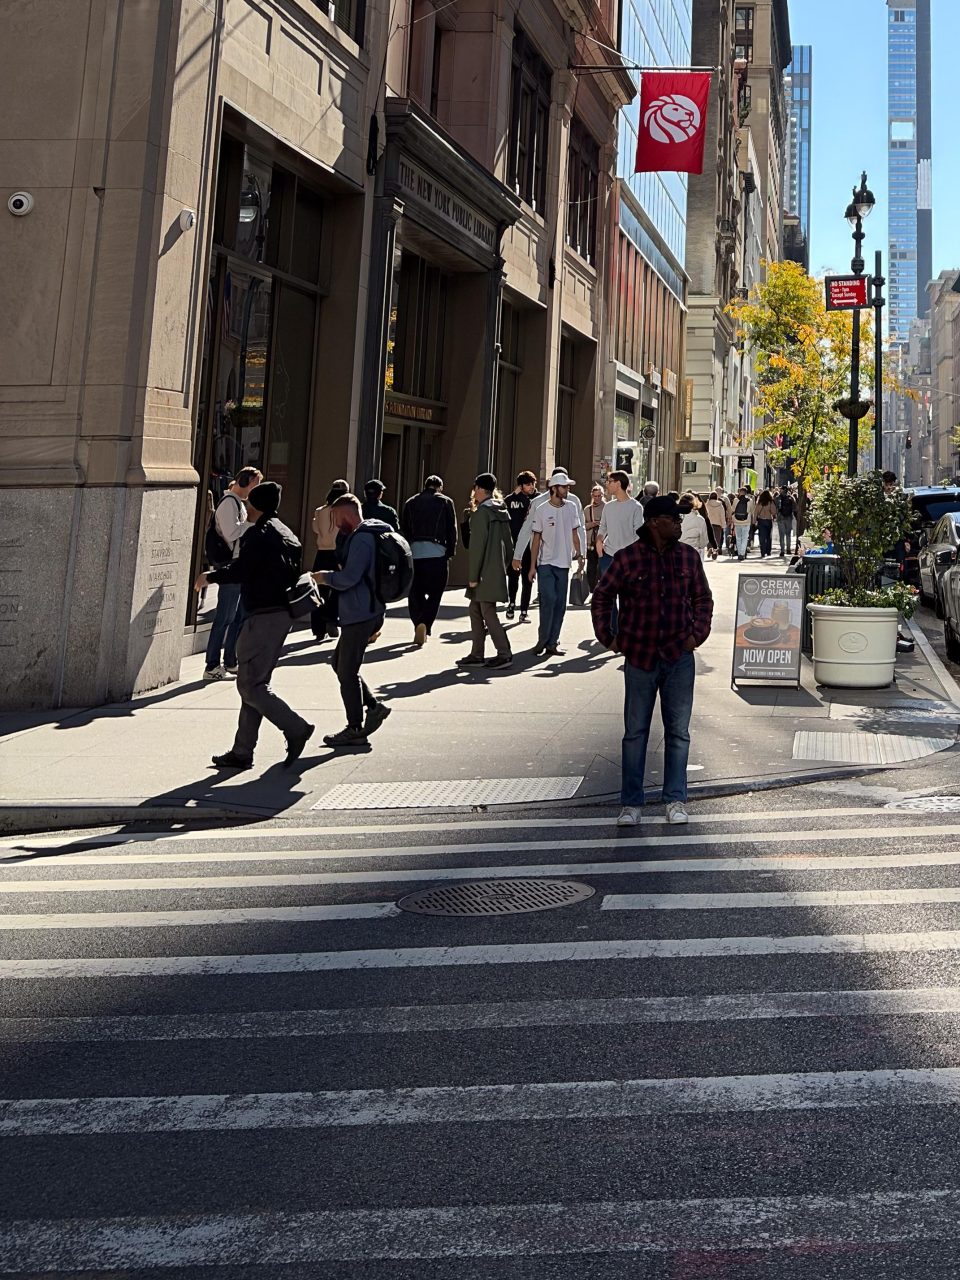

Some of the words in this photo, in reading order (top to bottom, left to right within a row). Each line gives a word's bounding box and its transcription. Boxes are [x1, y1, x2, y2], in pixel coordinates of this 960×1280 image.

[400, 161, 415, 192] THE
[417, 176, 432, 204] NEW
[434, 187, 451, 217] YORK
[451, 200, 472, 232] PUBLIC
[473, 220, 495, 248] LIBRARY
[760, 579, 800, 589] CREMA
[760, 588, 800, 596] GOURMET
[743, 648, 766, 664] NOW
[767, 649, 792, 664] OPEN
